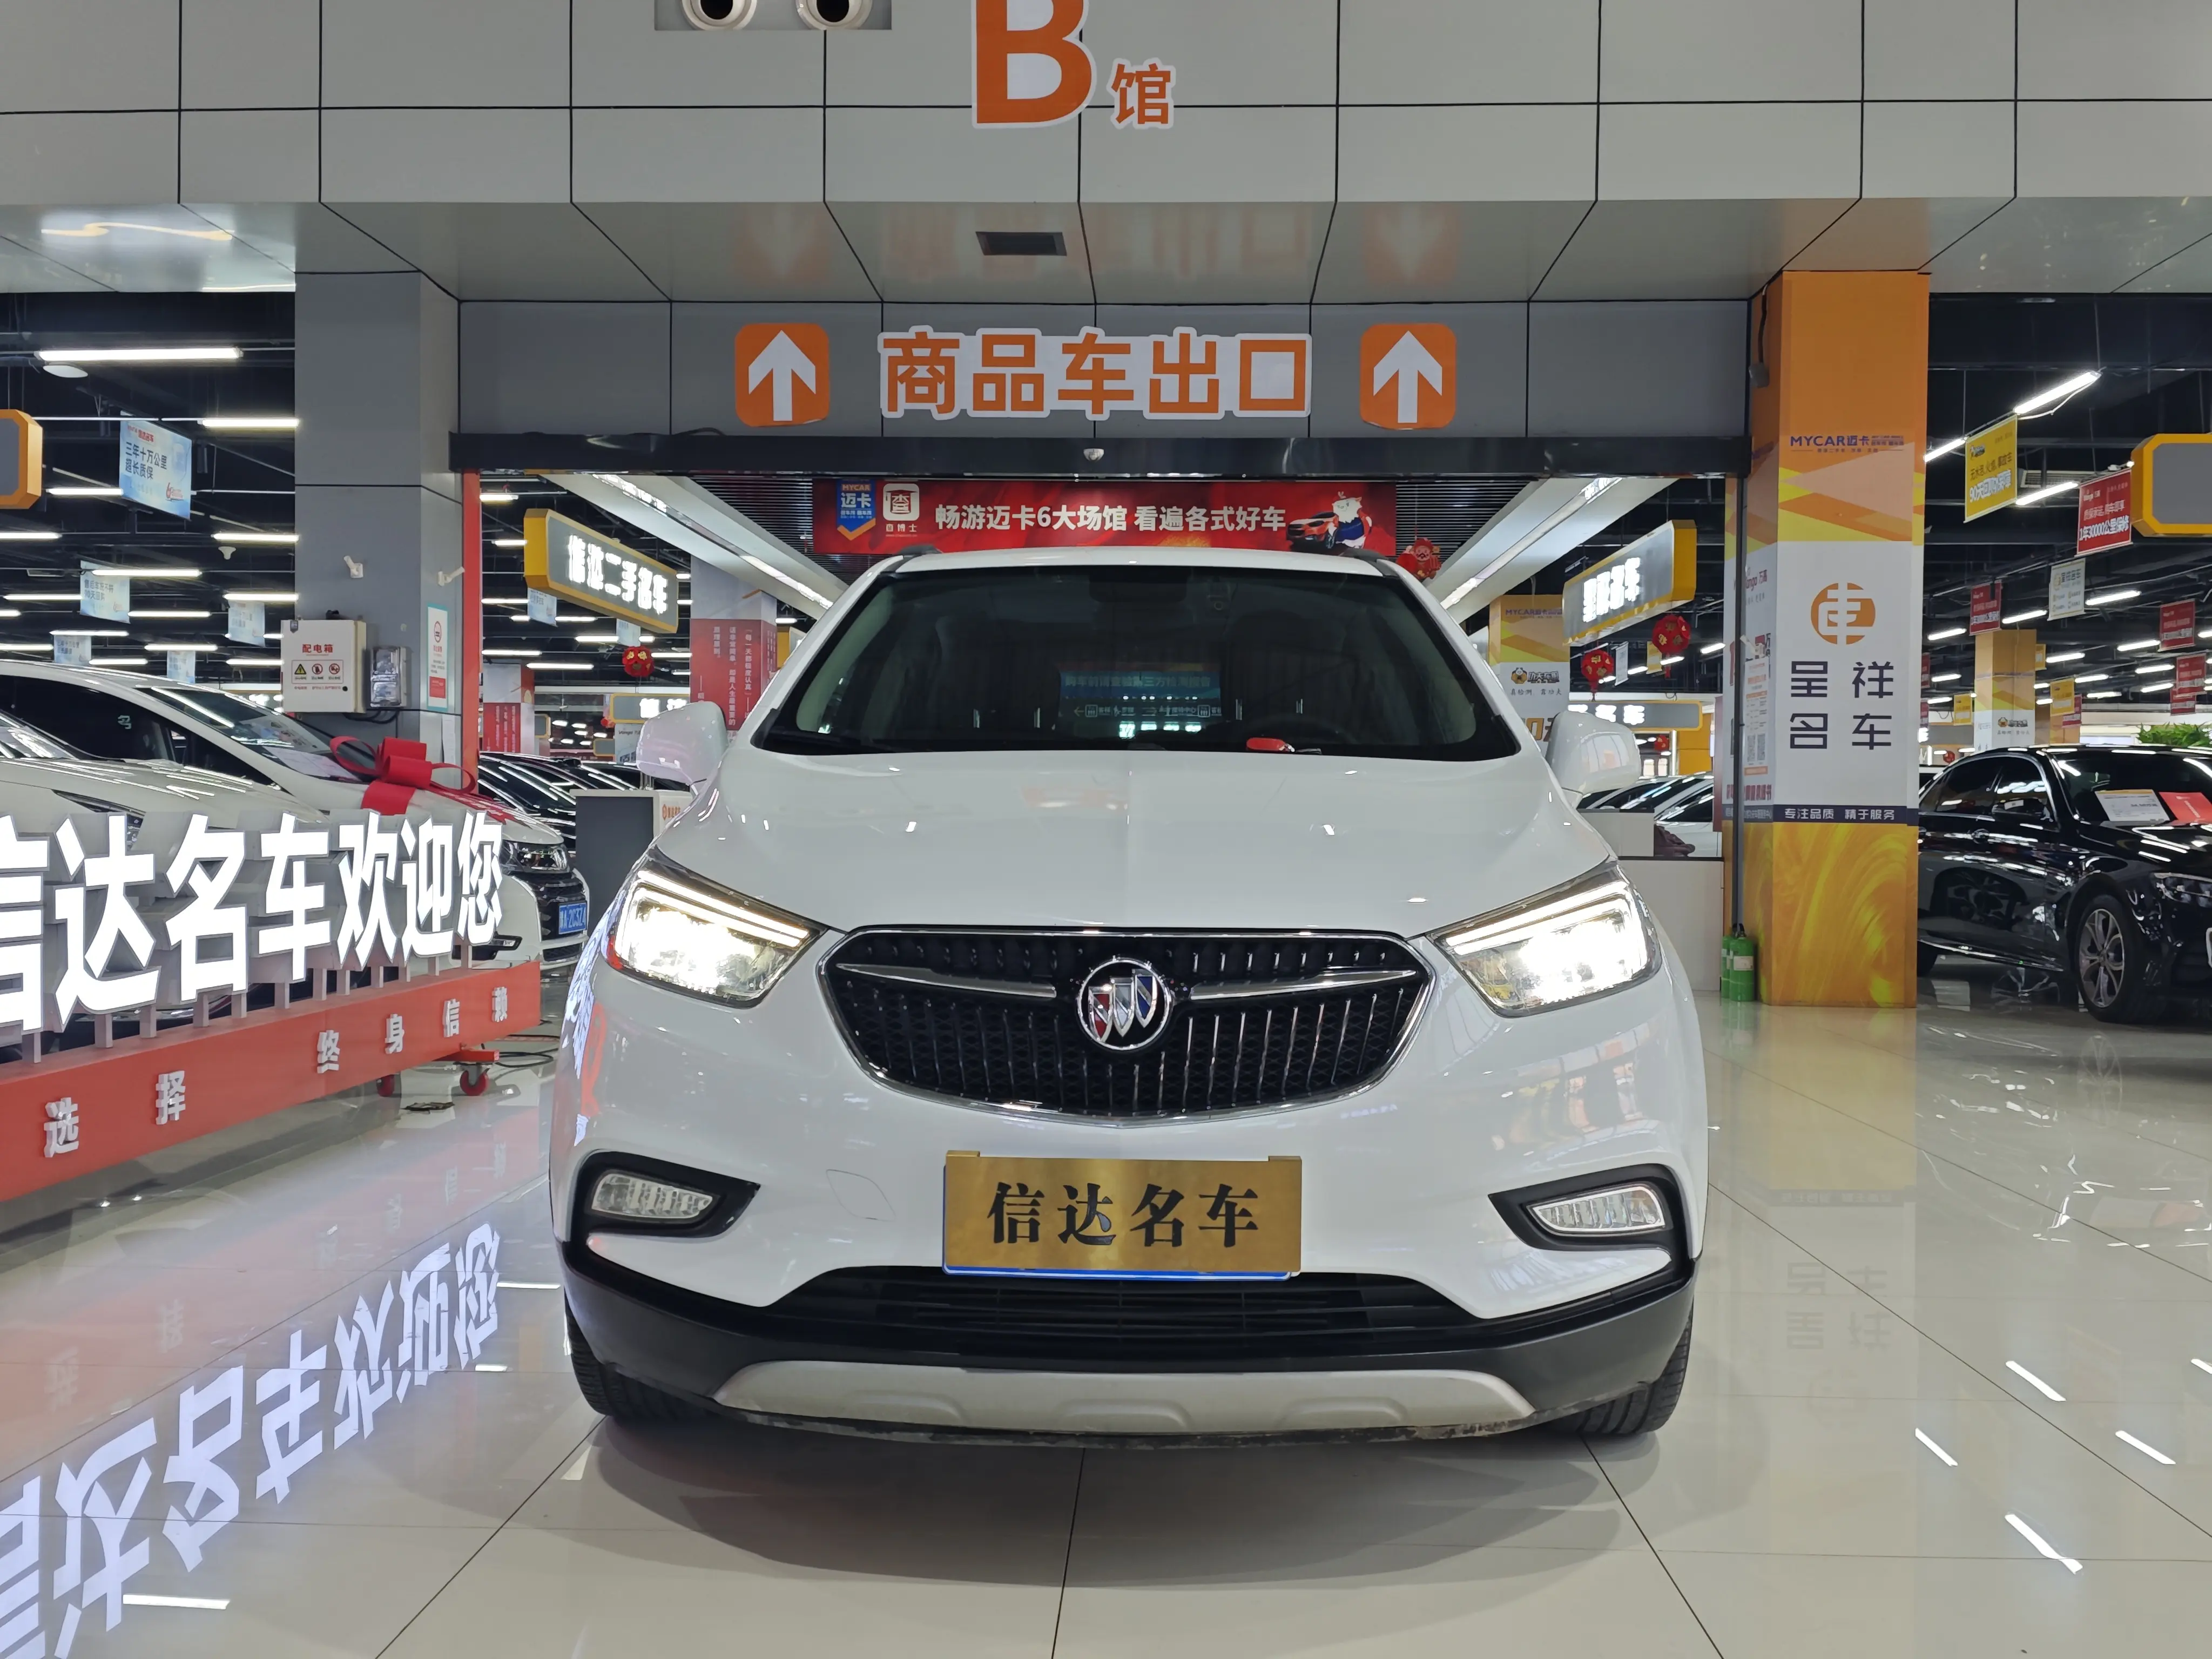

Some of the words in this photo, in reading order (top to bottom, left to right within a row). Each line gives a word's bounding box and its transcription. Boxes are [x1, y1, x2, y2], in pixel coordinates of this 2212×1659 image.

[882, 331, 1306, 415] 商品车出口
[125, 441, 167, 470] 三年十万公里
[841, 493, 872, 508] 迈卡
[935, 504, 1128, 531] 畅游迈卡6大场馆
[1134, 505, 1286, 531] 看遍各式好车
[302, 644, 333, 653] 配电箱
[1790, 661, 1894, 699] 呈祥
[1790, 713, 1892, 750] 名车
[1784, 808, 1835, 820] 专注品质
[1844, 808, 1895, 820] 精于服务
[987, 1181, 1259, 1249] 信达名车
